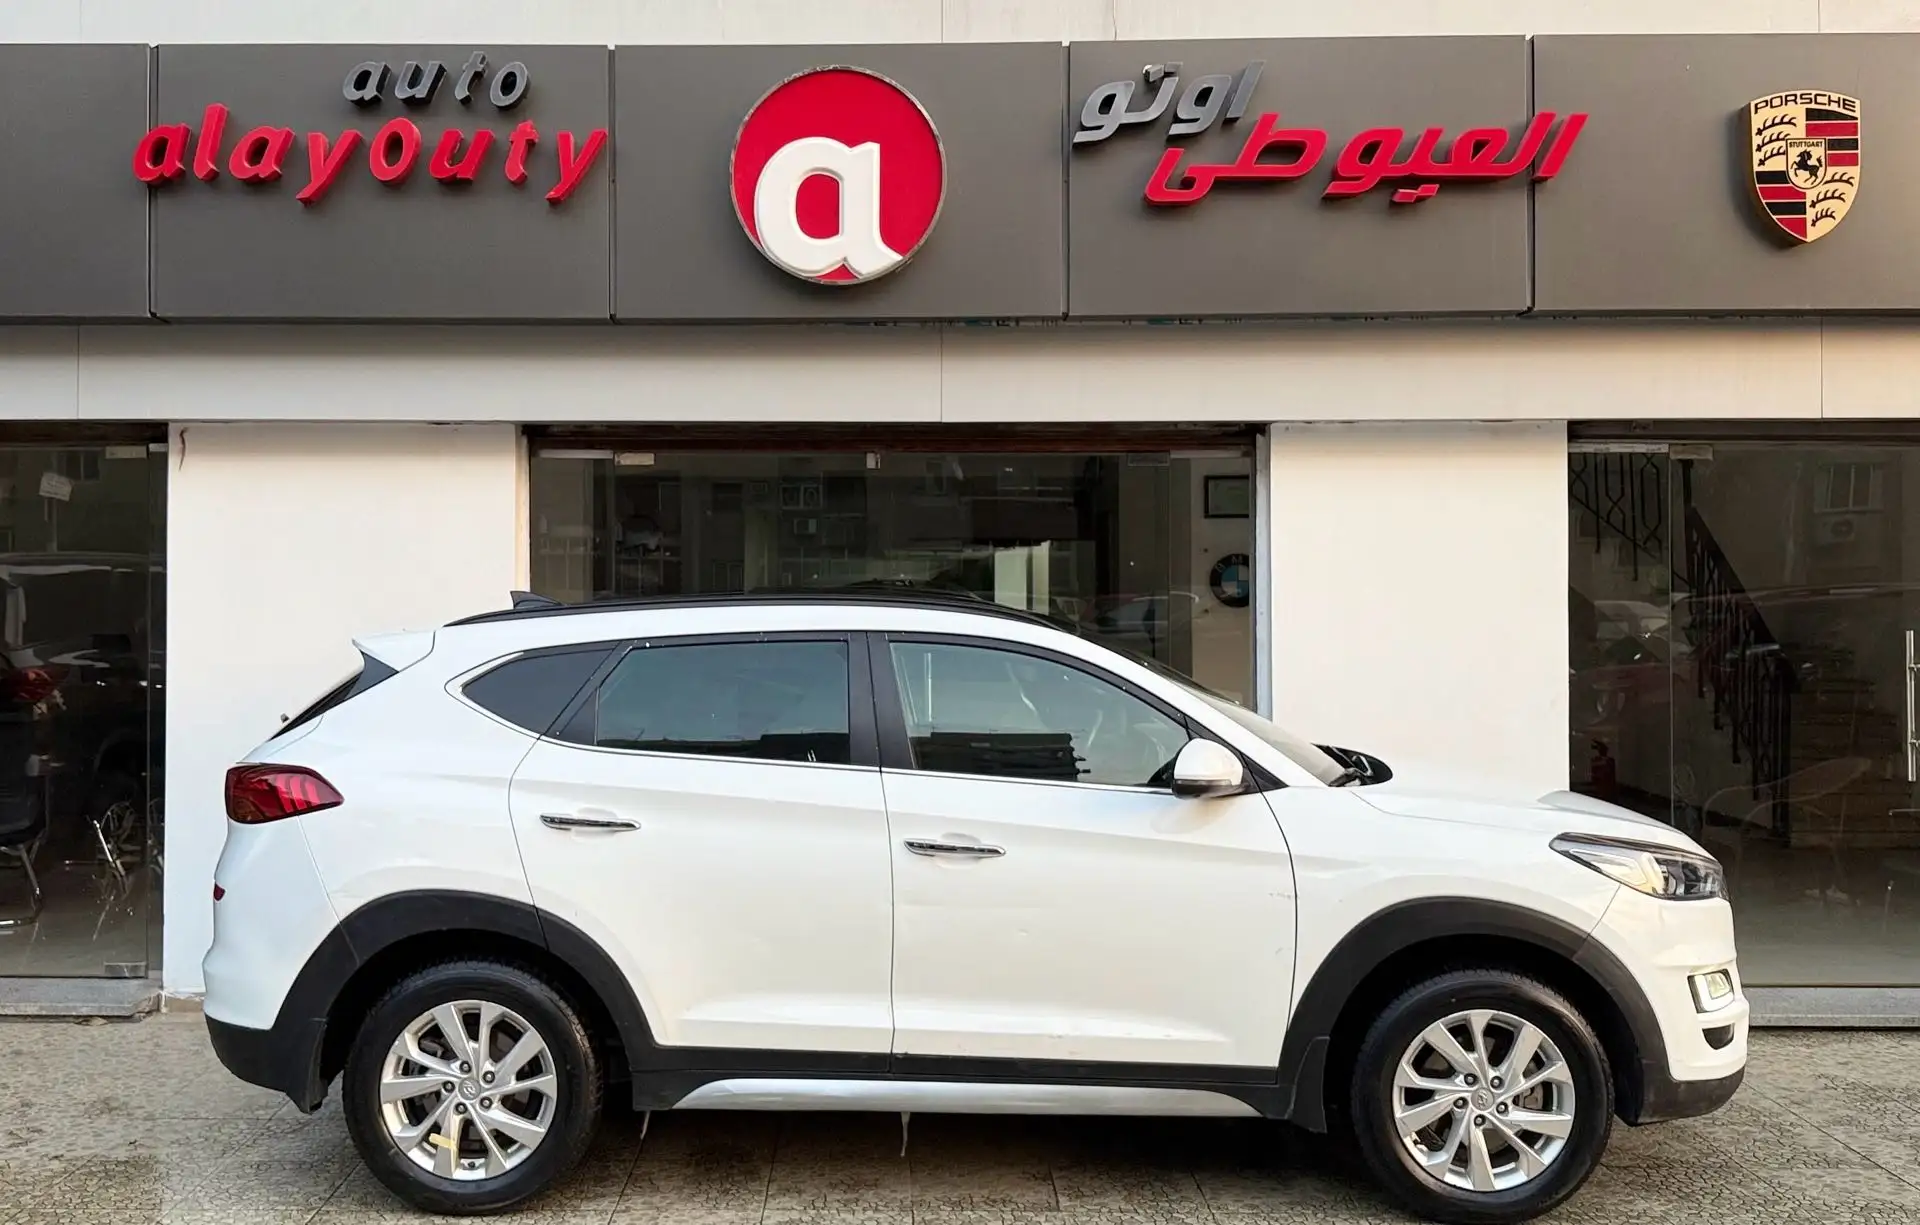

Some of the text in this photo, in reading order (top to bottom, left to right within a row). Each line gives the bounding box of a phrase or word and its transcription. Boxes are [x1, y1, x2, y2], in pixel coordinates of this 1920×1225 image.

[343, 51, 530, 108] auto
[1073, 60, 1265, 144] اوتو
[1754, 92, 1857, 115] PORSCHE
[1788, 140, 1823, 149] STUTTGART
[753, 136, 904, 278] a
